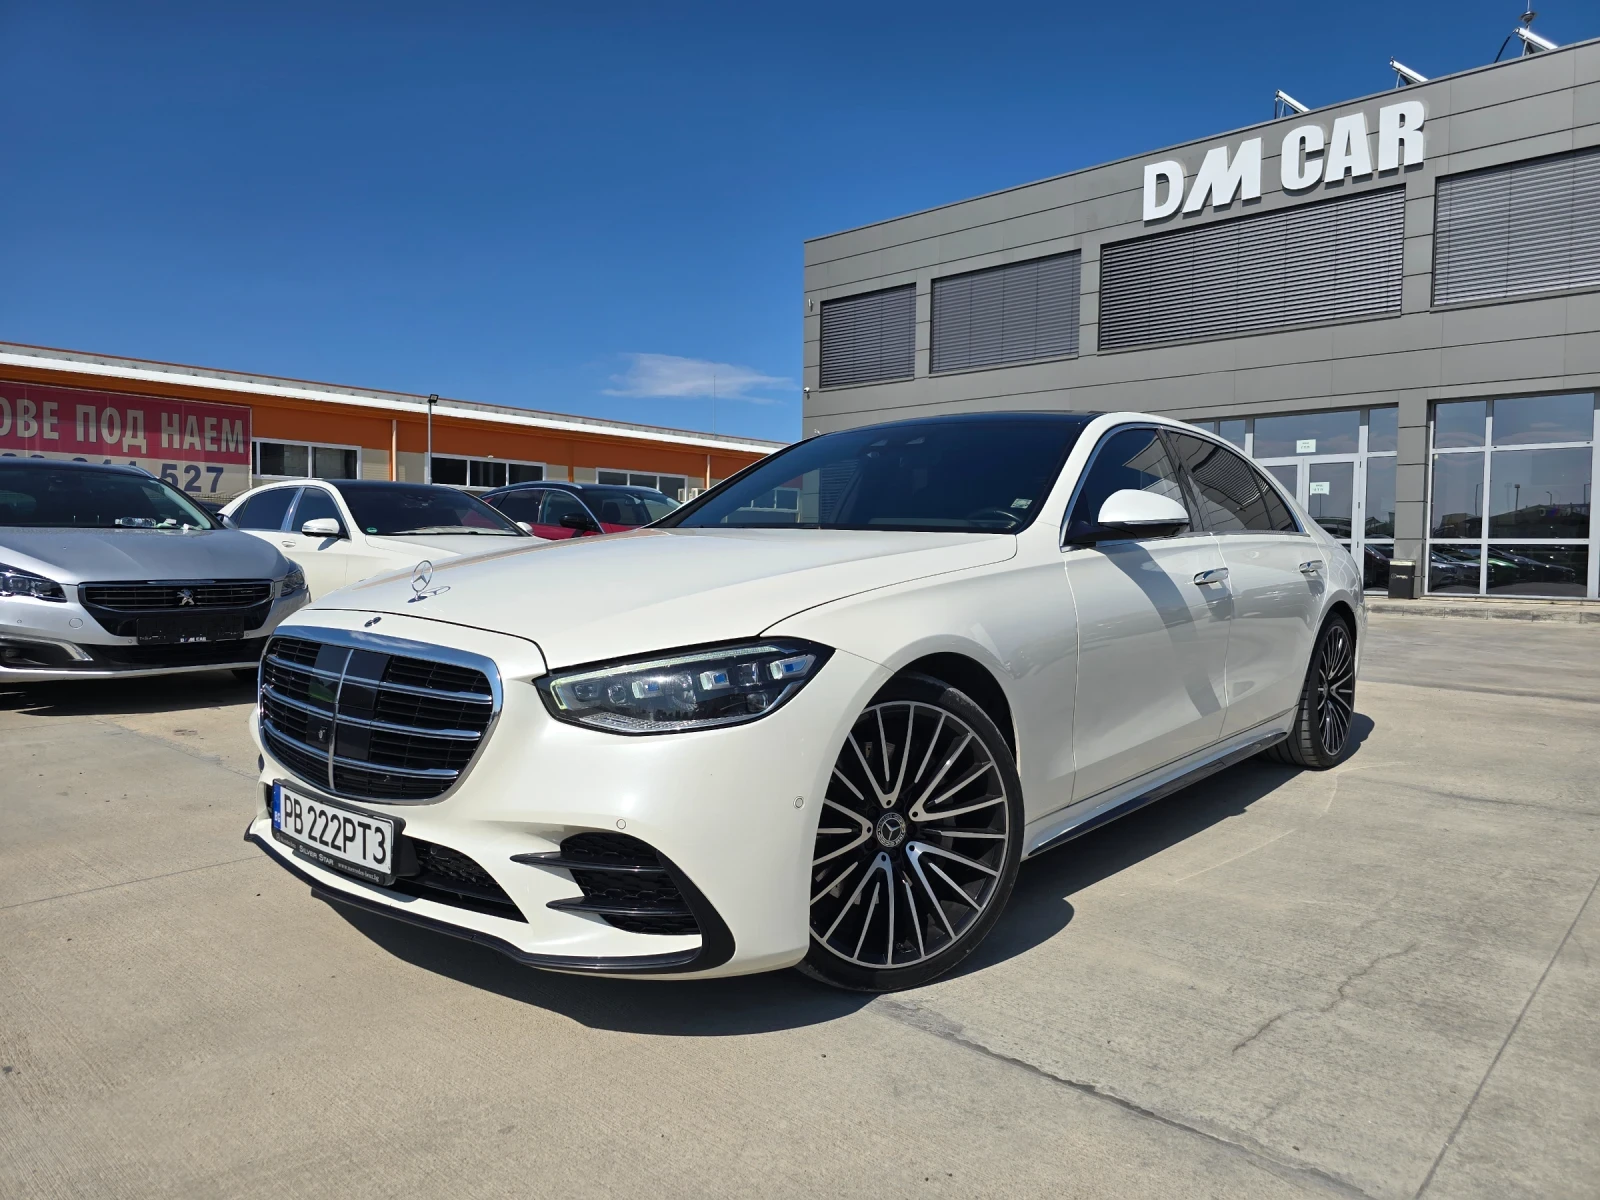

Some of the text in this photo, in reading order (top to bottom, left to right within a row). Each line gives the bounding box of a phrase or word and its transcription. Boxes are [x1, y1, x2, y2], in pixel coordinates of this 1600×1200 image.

[1142, 100, 1426, 222] DM CAR
[76, 404, 147, 454] ПОД
[161, 412, 244, 453] НАЕМ
[160, 463, 225, 493] 527
[318, 853, 334, 866] STAR
